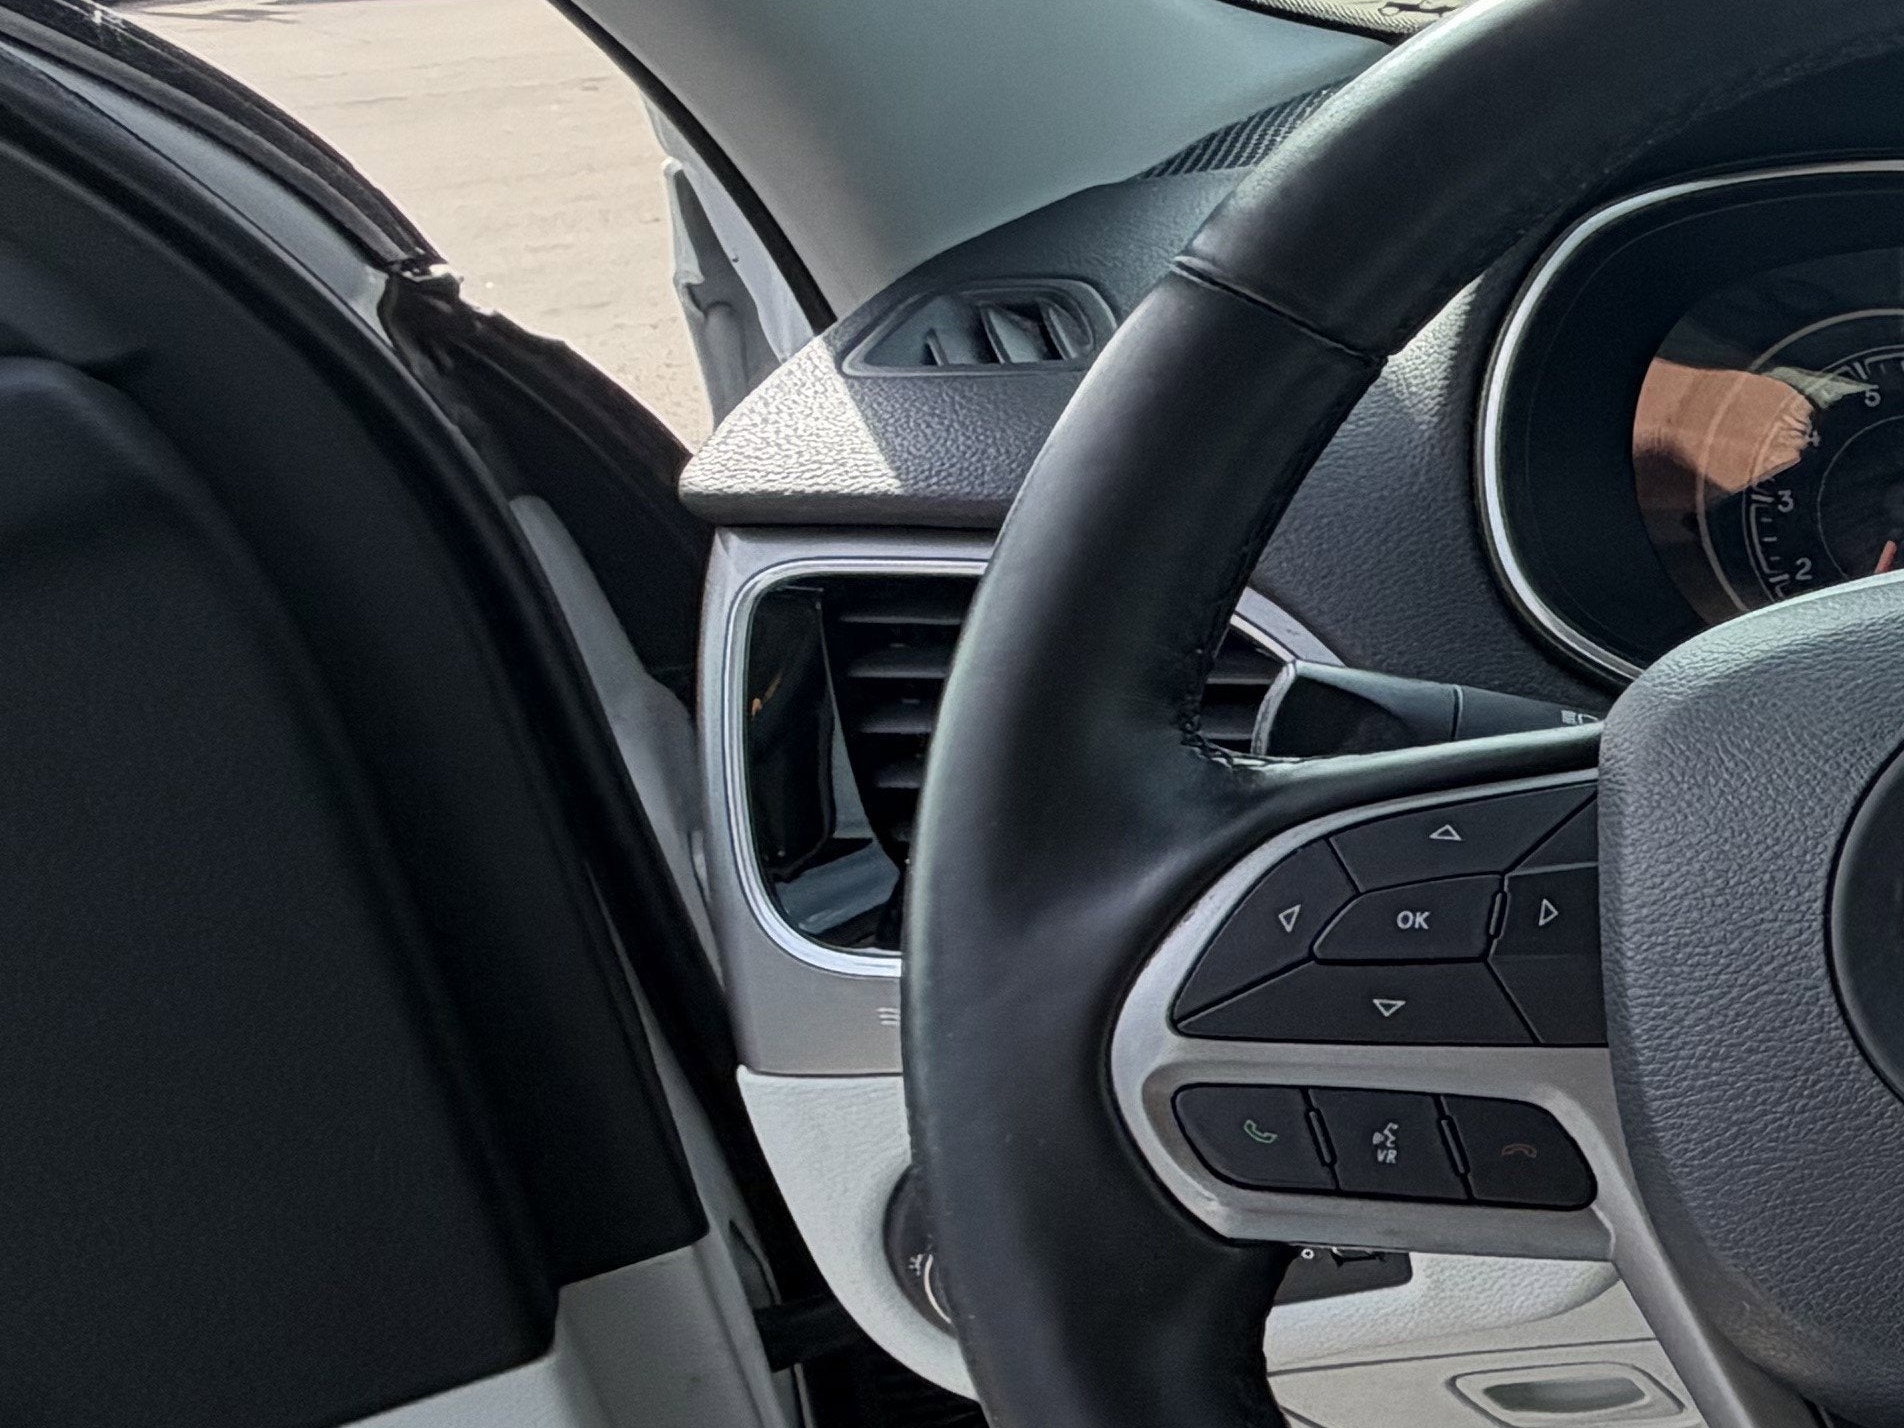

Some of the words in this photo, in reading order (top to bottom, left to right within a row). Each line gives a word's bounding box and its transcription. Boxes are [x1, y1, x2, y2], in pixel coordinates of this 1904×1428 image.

[1863, 385, 1882, 407] 5
[1776, 489, 1795, 513] 3
[1795, 556, 1812, 581] 2
[1396, 909, 1431, 931] OK
[1376, 1148, 1398, 1164] VR
